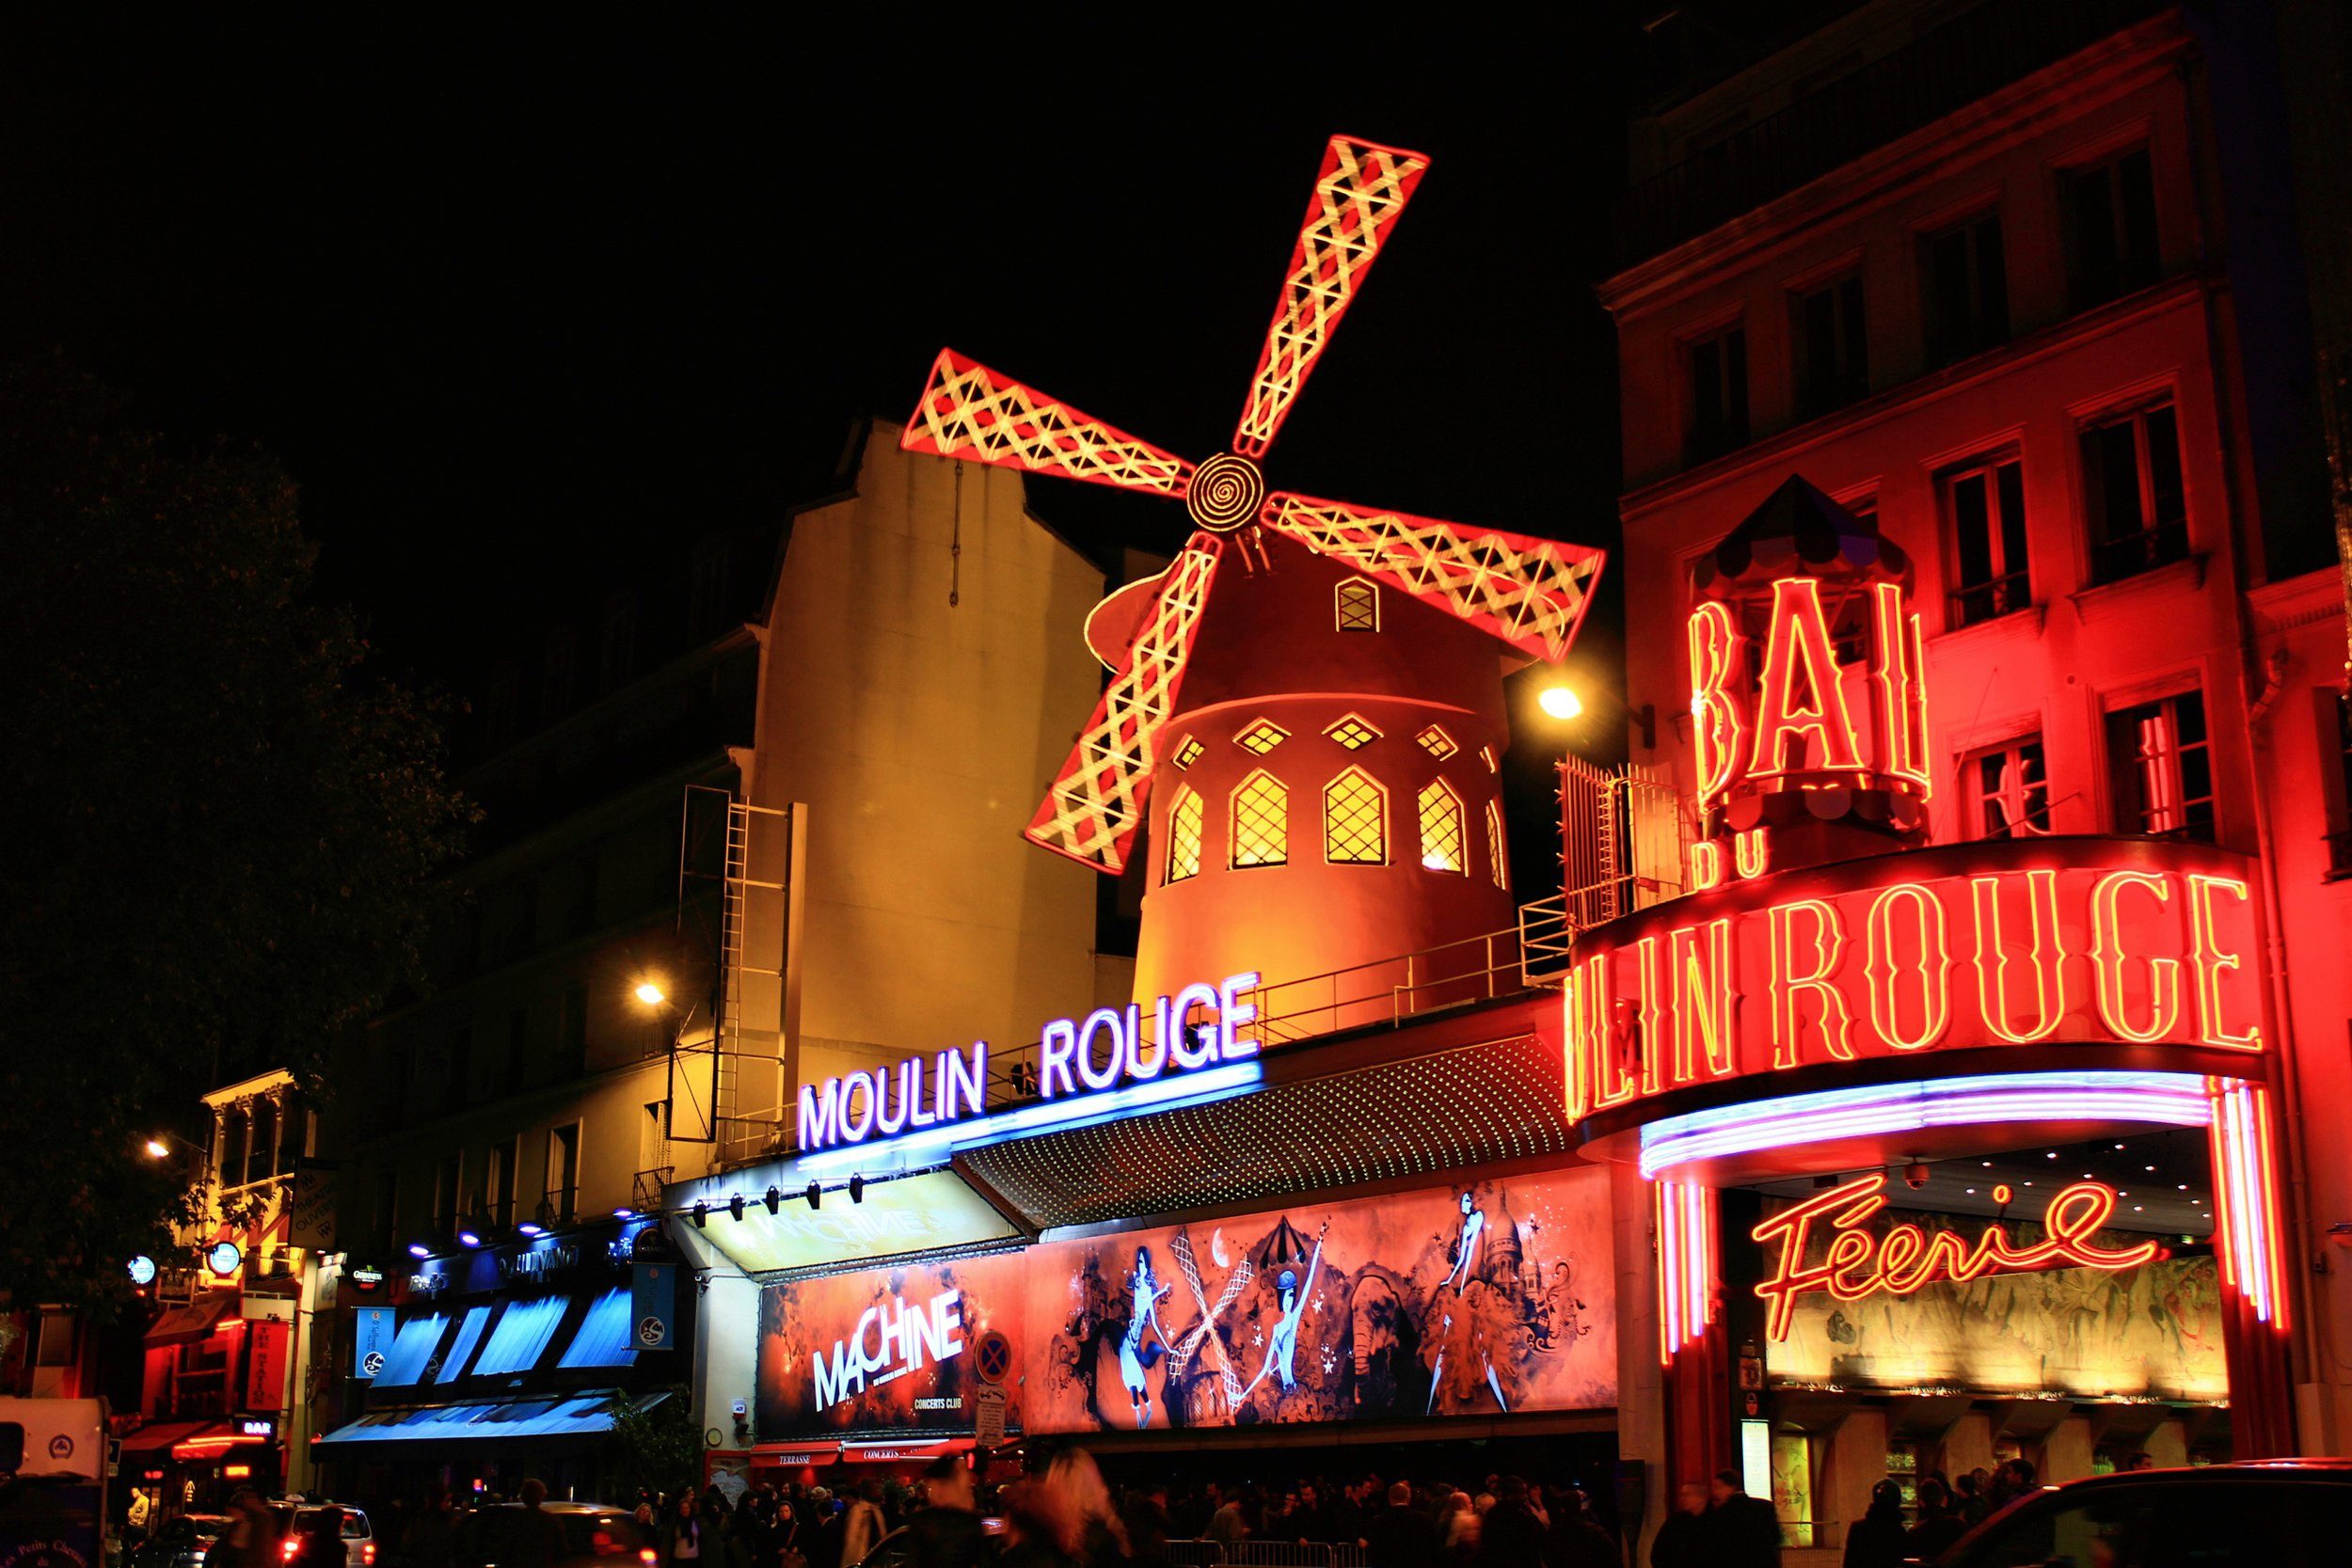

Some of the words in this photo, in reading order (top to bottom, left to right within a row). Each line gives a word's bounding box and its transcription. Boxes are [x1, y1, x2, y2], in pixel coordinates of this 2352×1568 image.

[1688, 578, 1931, 815] BAL
[1692, 829, 1765, 891] DU
[1769, 870, 2263, 1069] ROUGE
[799, 1039, 988, 1152] MOULIN
[1041, 972, 1263, 1100] ROUGE
[1752, 1172, 2162, 1343] Féerie
[813, 1289, 963, 1412] MACHINE
[244, 1421, 272, 1434] BAR
[914, 1398, 946, 1410] CONCERTS
[946, 1398, 962, 1409] CLUB
[779, 1454, 810, 1465] TERRASSE
[863, 1449, 899, 1460] CONCERTS
